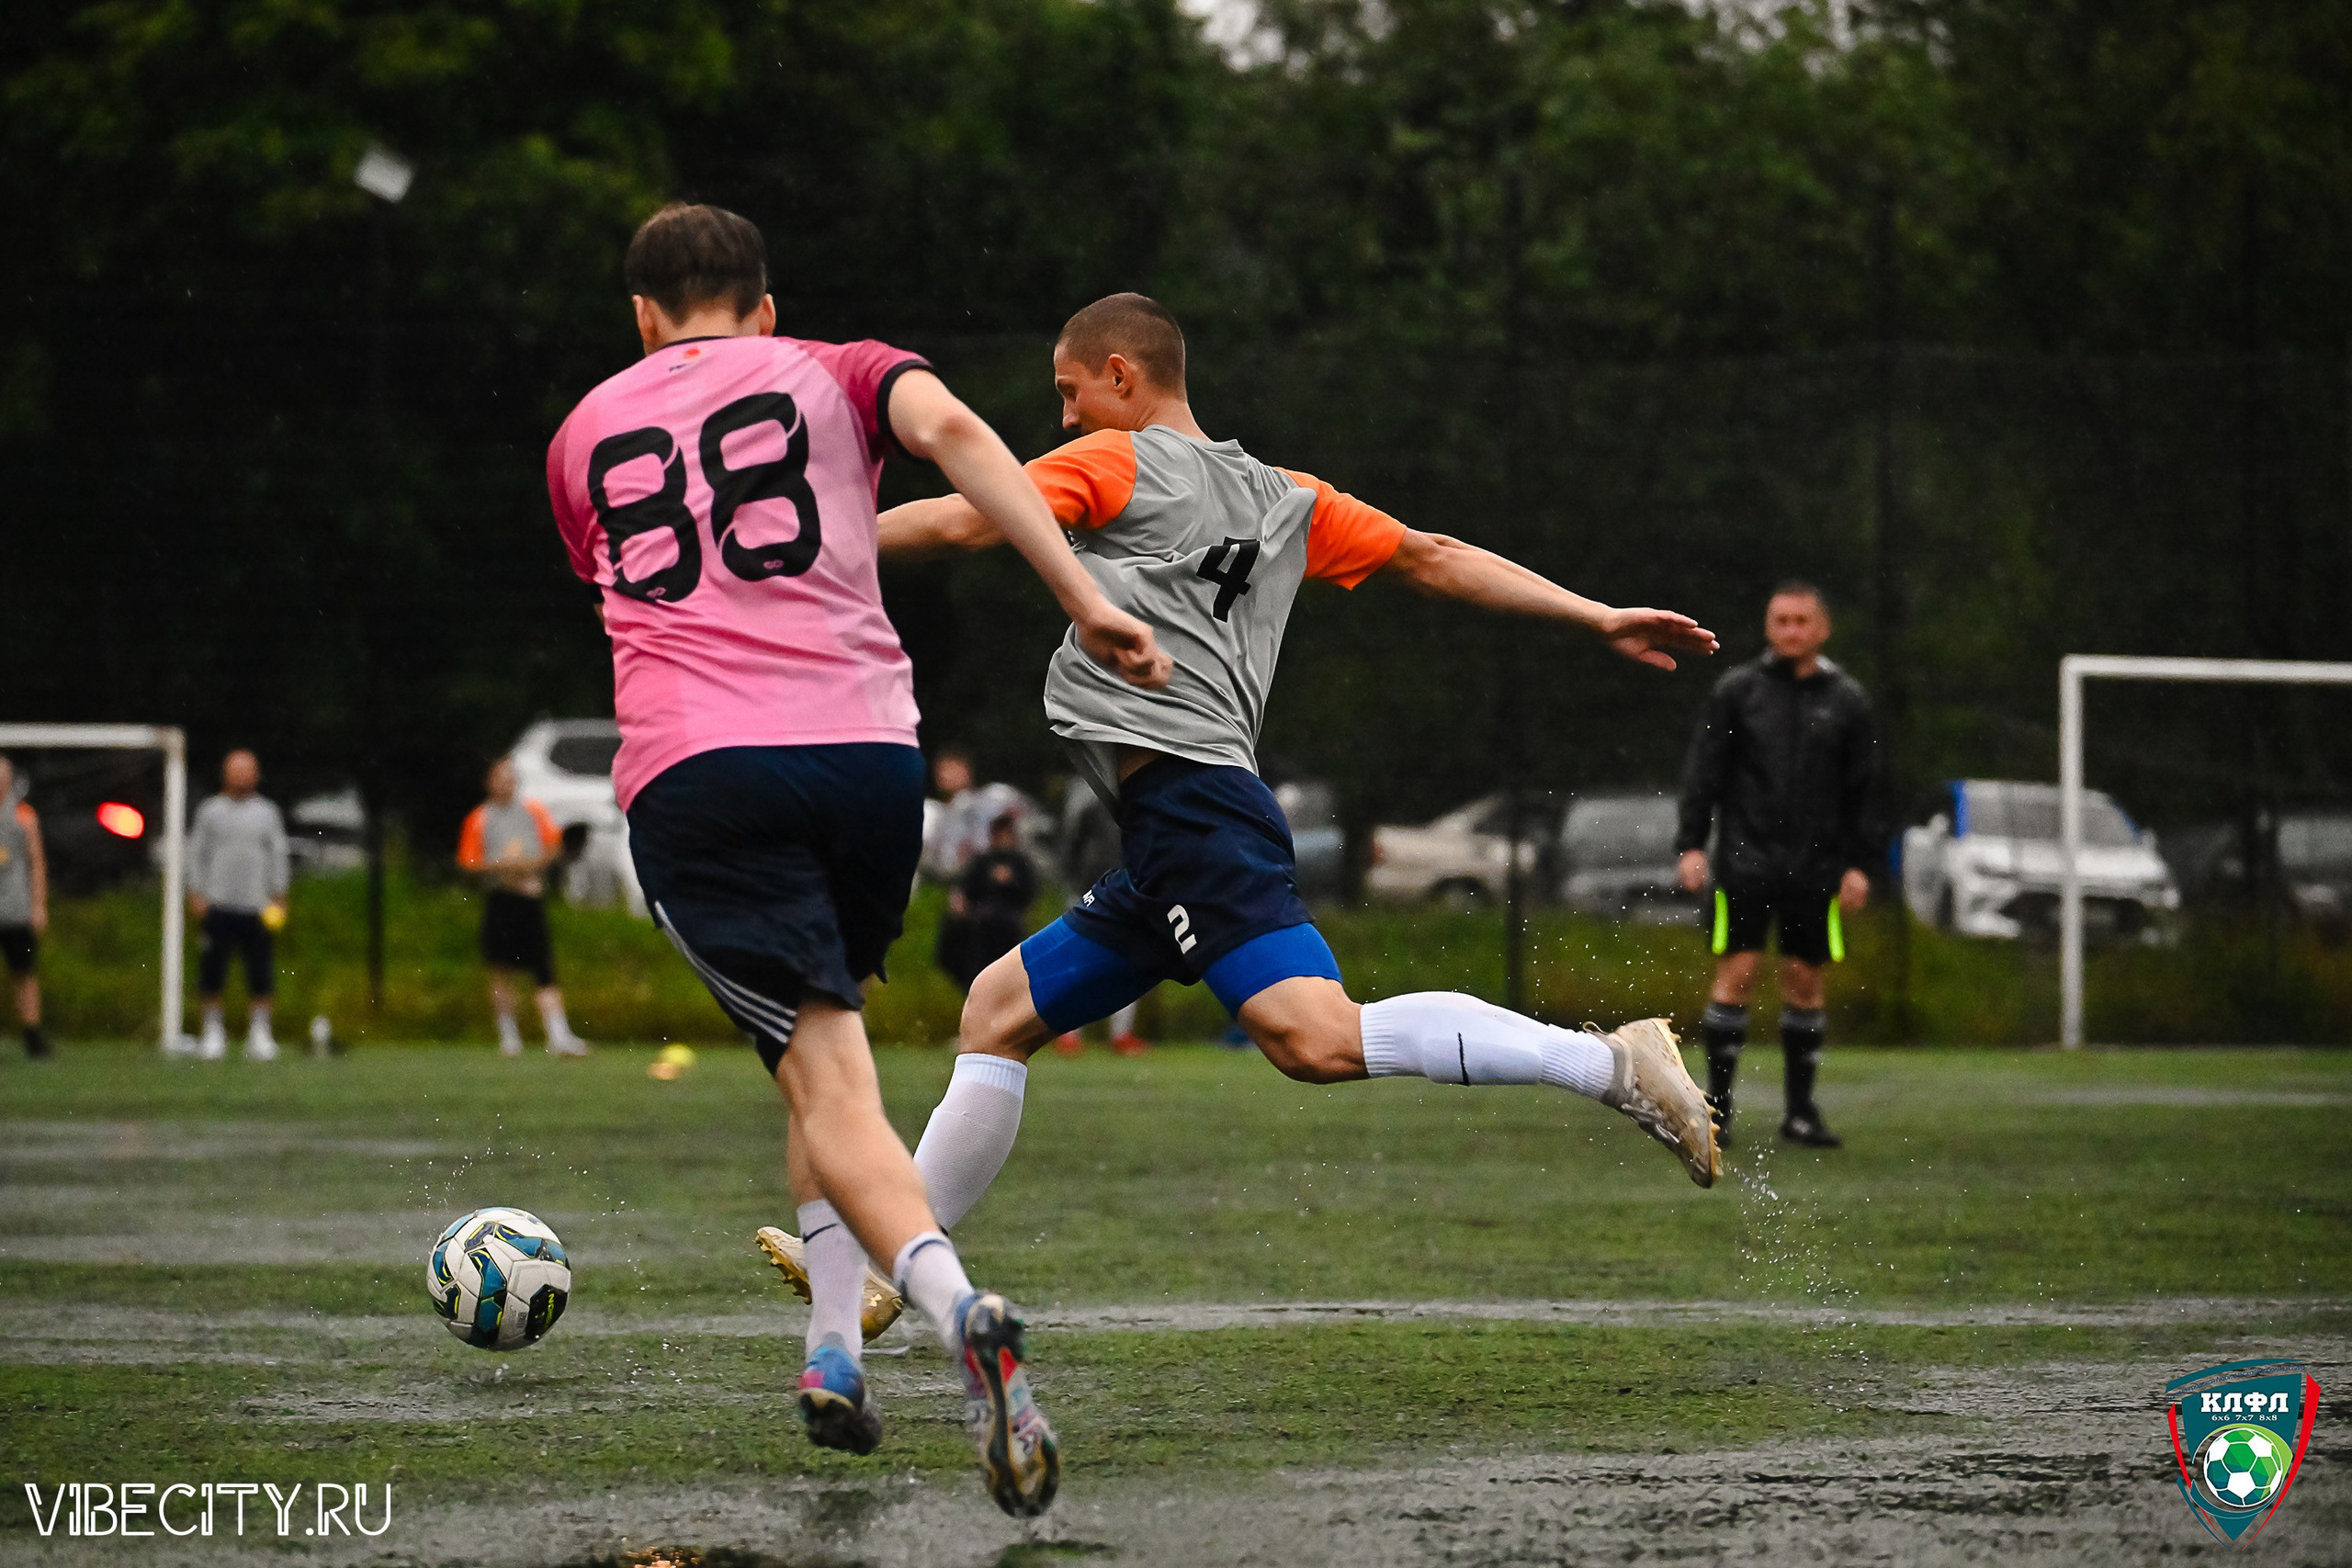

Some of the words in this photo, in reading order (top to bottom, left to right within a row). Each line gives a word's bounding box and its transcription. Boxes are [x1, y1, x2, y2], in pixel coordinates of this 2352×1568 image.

[588, 392, 821, 603] 88
[1196, 536, 1261, 623] 4
[1167, 904, 1197, 955] 2
